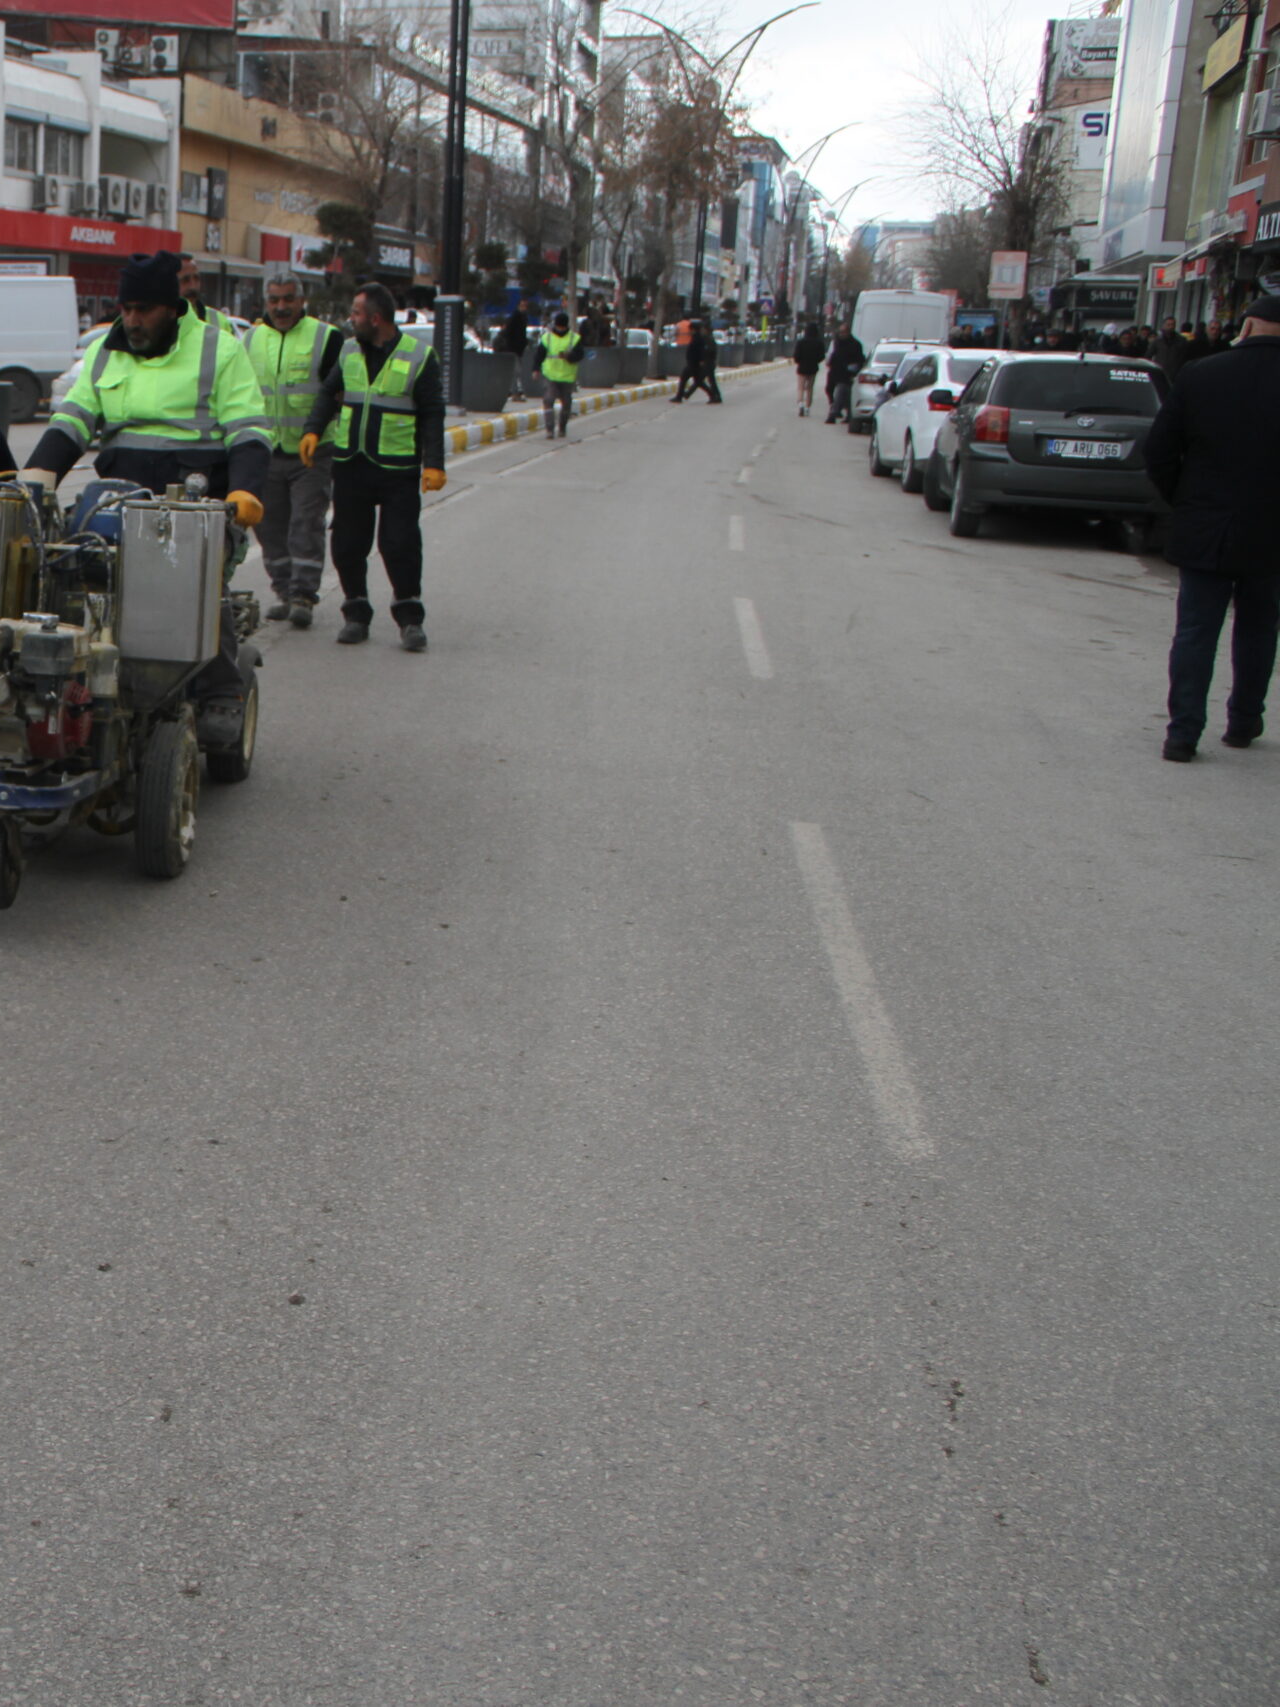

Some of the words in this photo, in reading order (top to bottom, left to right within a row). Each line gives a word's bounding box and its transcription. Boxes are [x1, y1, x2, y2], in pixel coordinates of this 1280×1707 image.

[70, 225, 117, 245] AKBANK
[1109, 369, 1150, 378] SATILIK
[1053, 441, 1067, 452] 07
[1072, 442, 1093, 454] ARU
[1097, 443, 1118, 456] 066
